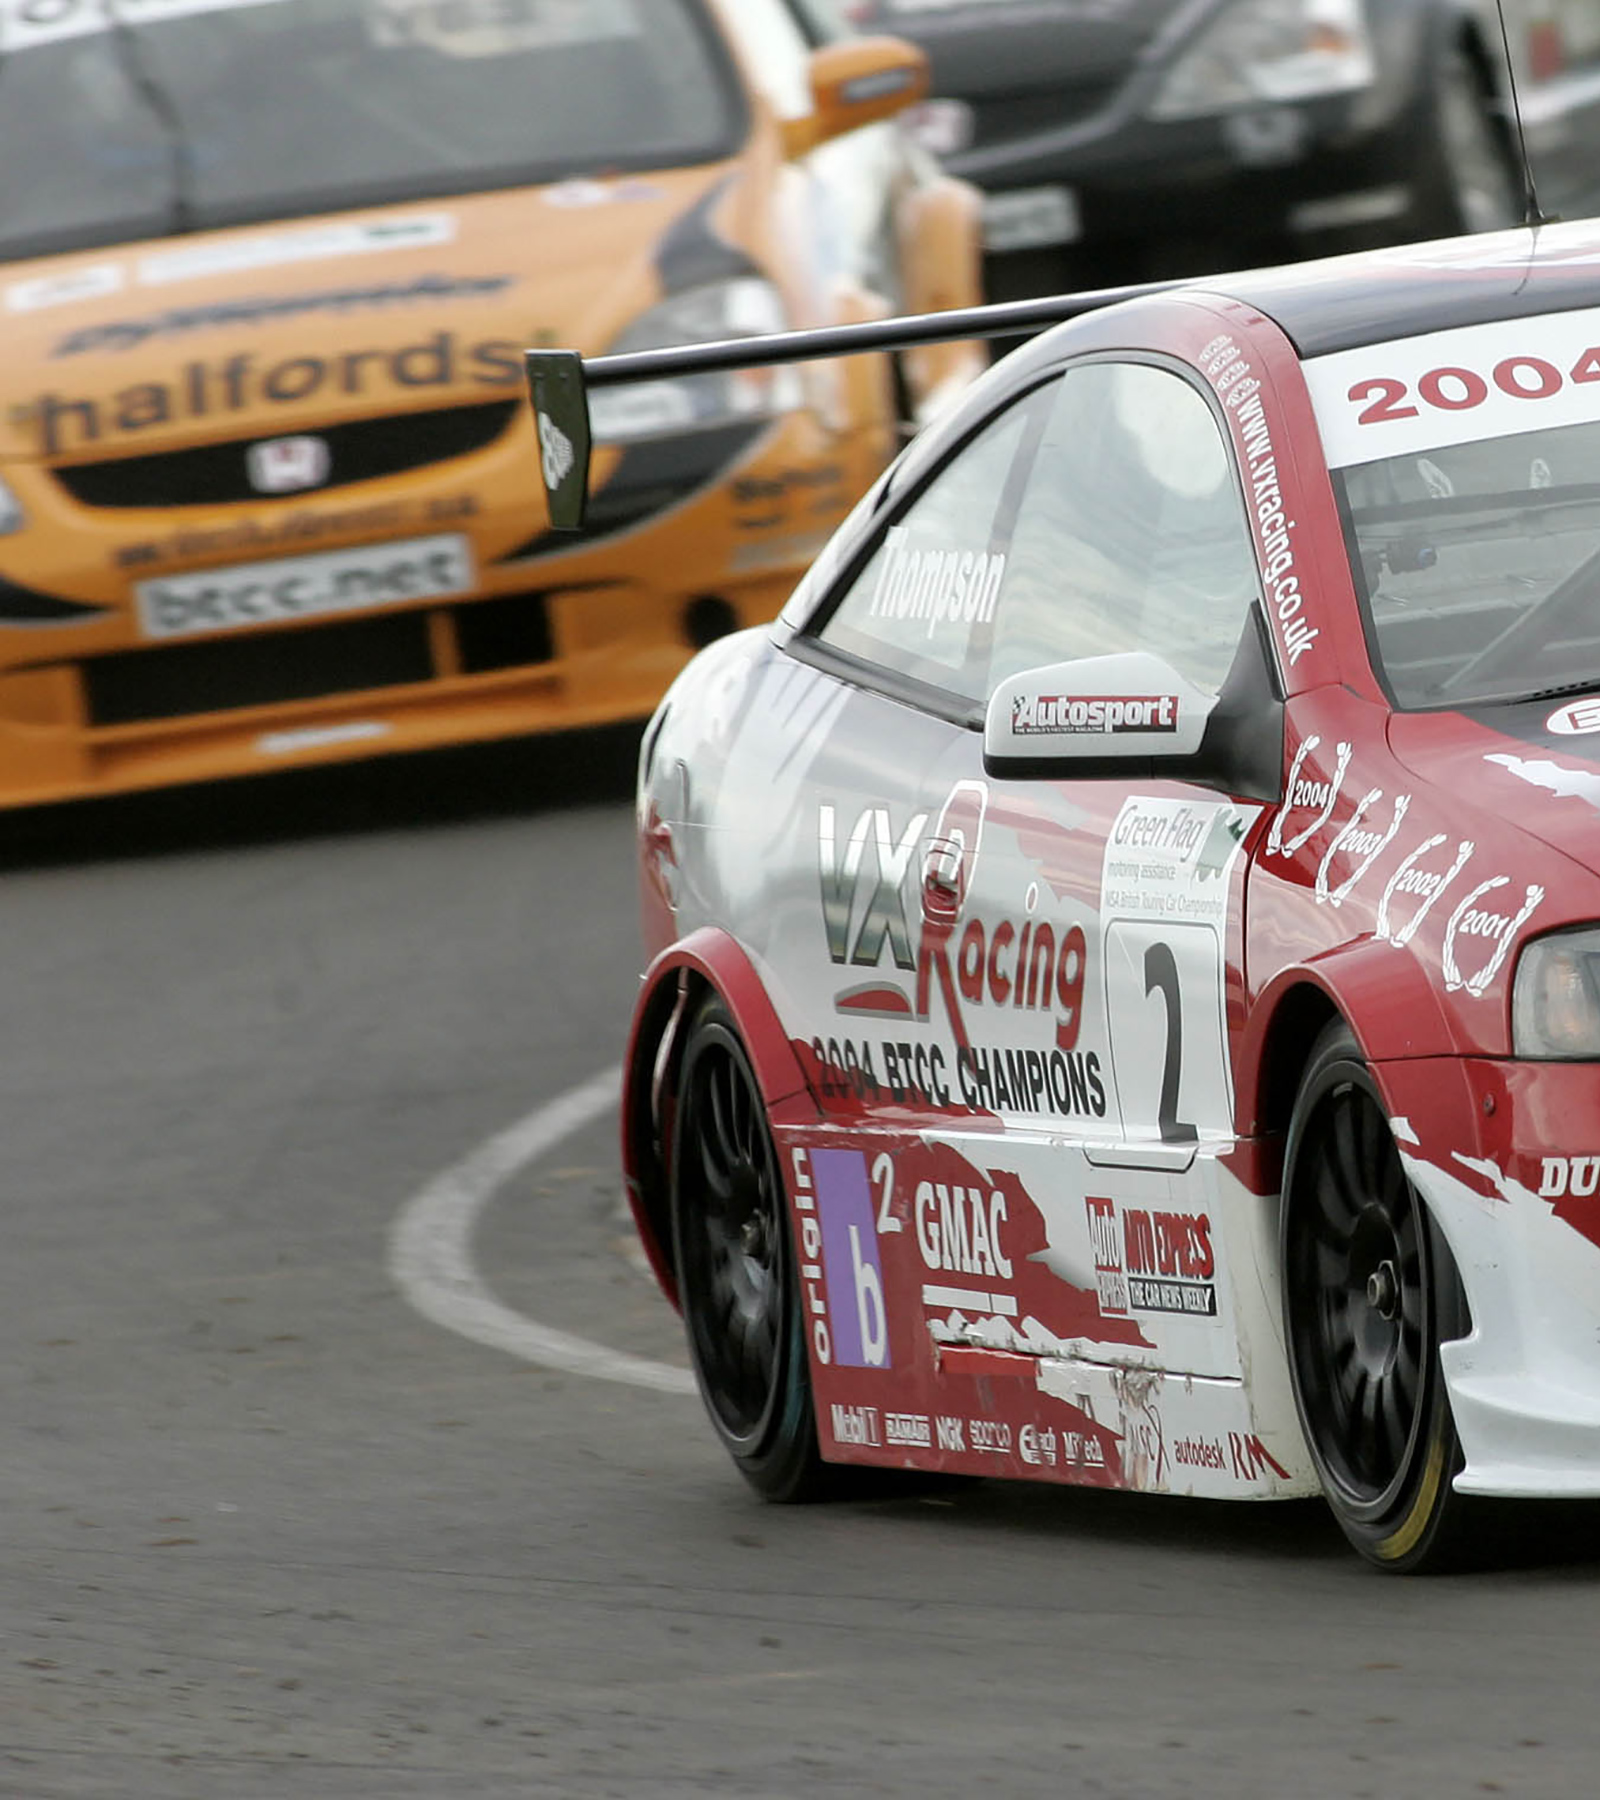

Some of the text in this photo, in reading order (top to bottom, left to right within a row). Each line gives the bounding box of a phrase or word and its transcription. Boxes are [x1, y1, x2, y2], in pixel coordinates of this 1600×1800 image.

[36, 329, 527, 459] halfords
[1236, 394, 1320, 666] www.vxracing.co.uk
[869, 525, 1006, 639] Thompson
[1014, 695, 1173, 733] Autosport
[1294, 780, 1331, 808] 2004
[1115, 804, 1207, 863] Green Flag
[1397, 869, 1441, 895] 2002
[1460, 910, 1509, 939] 2001
[813, 1036, 1107, 1118] 2004 BTCC CHAMPIONS
[1144, 941, 1199, 1143] 2
[791, 1147, 832, 1365] origin
[915, 1181, 1014, 1279] GMAC
[935, 1415, 966, 1452] NGK
[1173, 1435, 1227, 1471] autodesk
